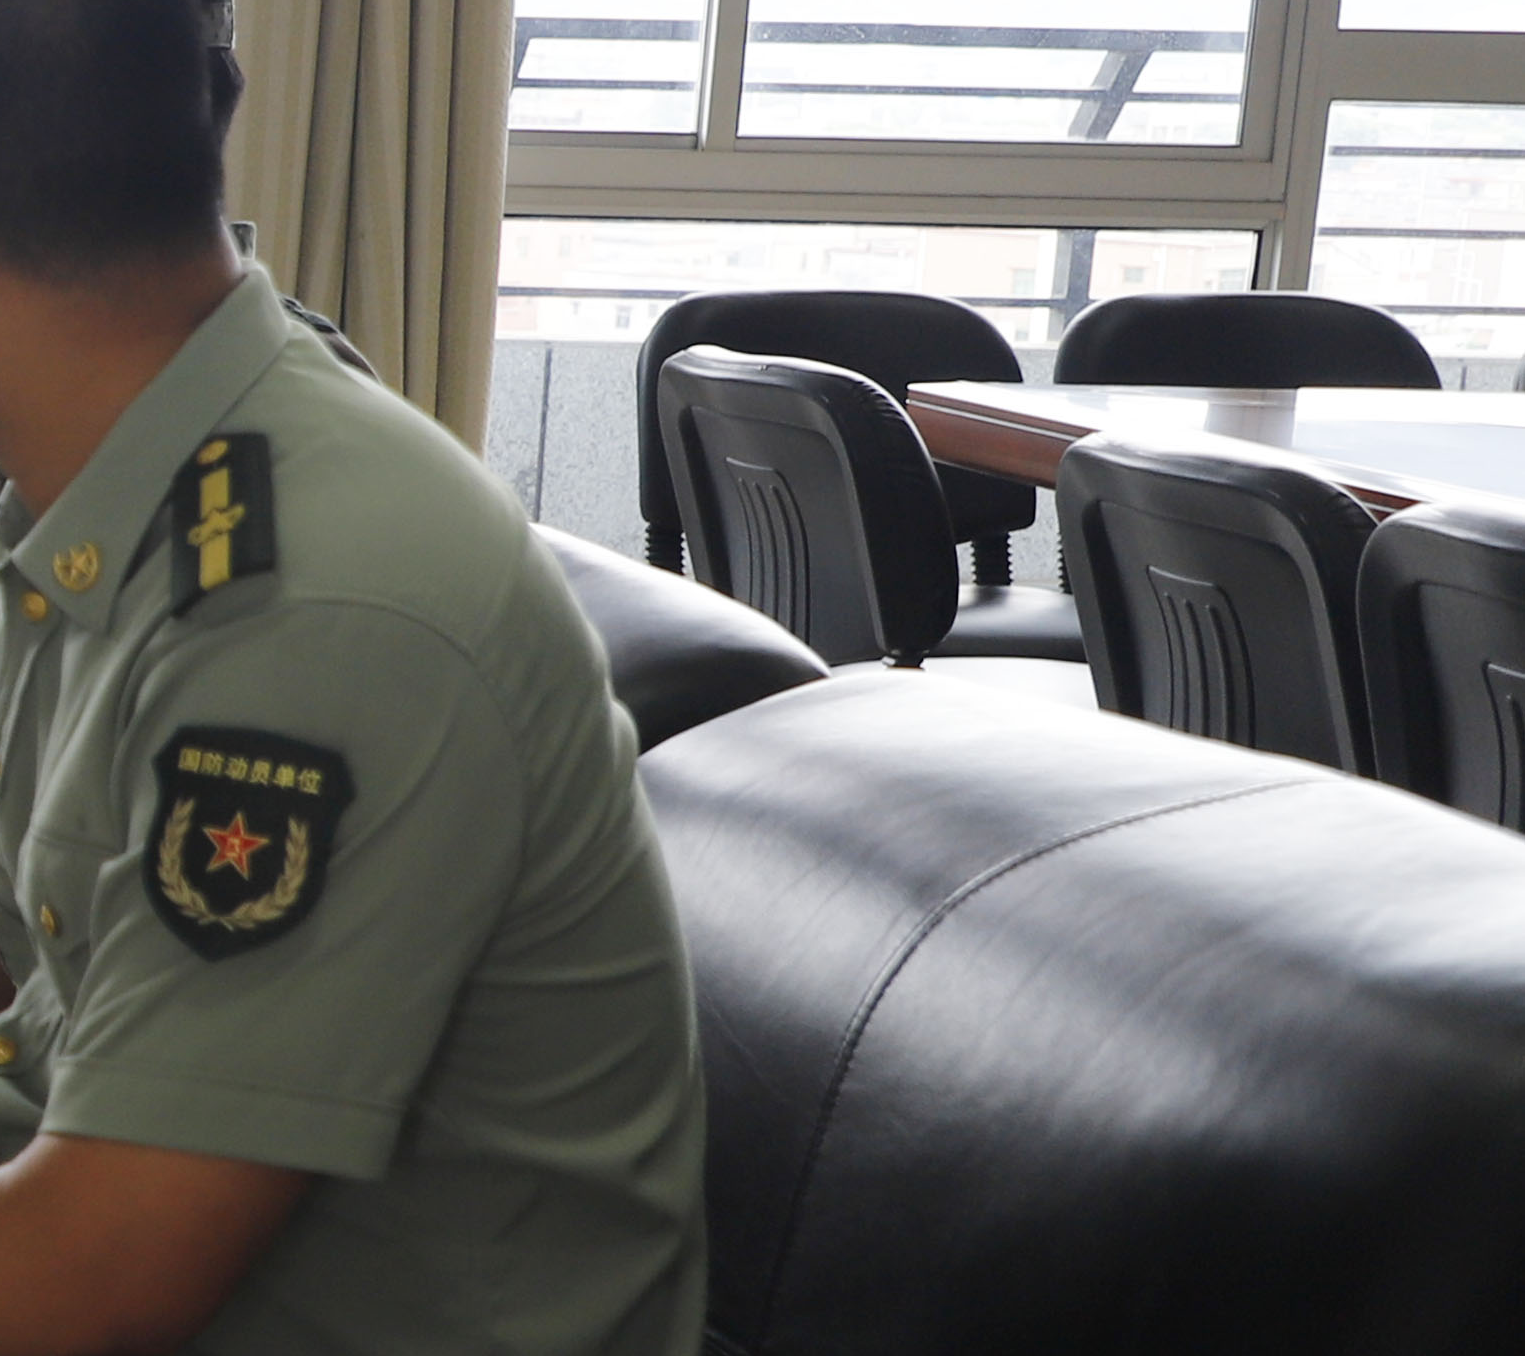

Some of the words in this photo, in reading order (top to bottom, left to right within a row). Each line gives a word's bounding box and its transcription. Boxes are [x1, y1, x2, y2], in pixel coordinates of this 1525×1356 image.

[178, 747, 322, 796] 国防动员单位
